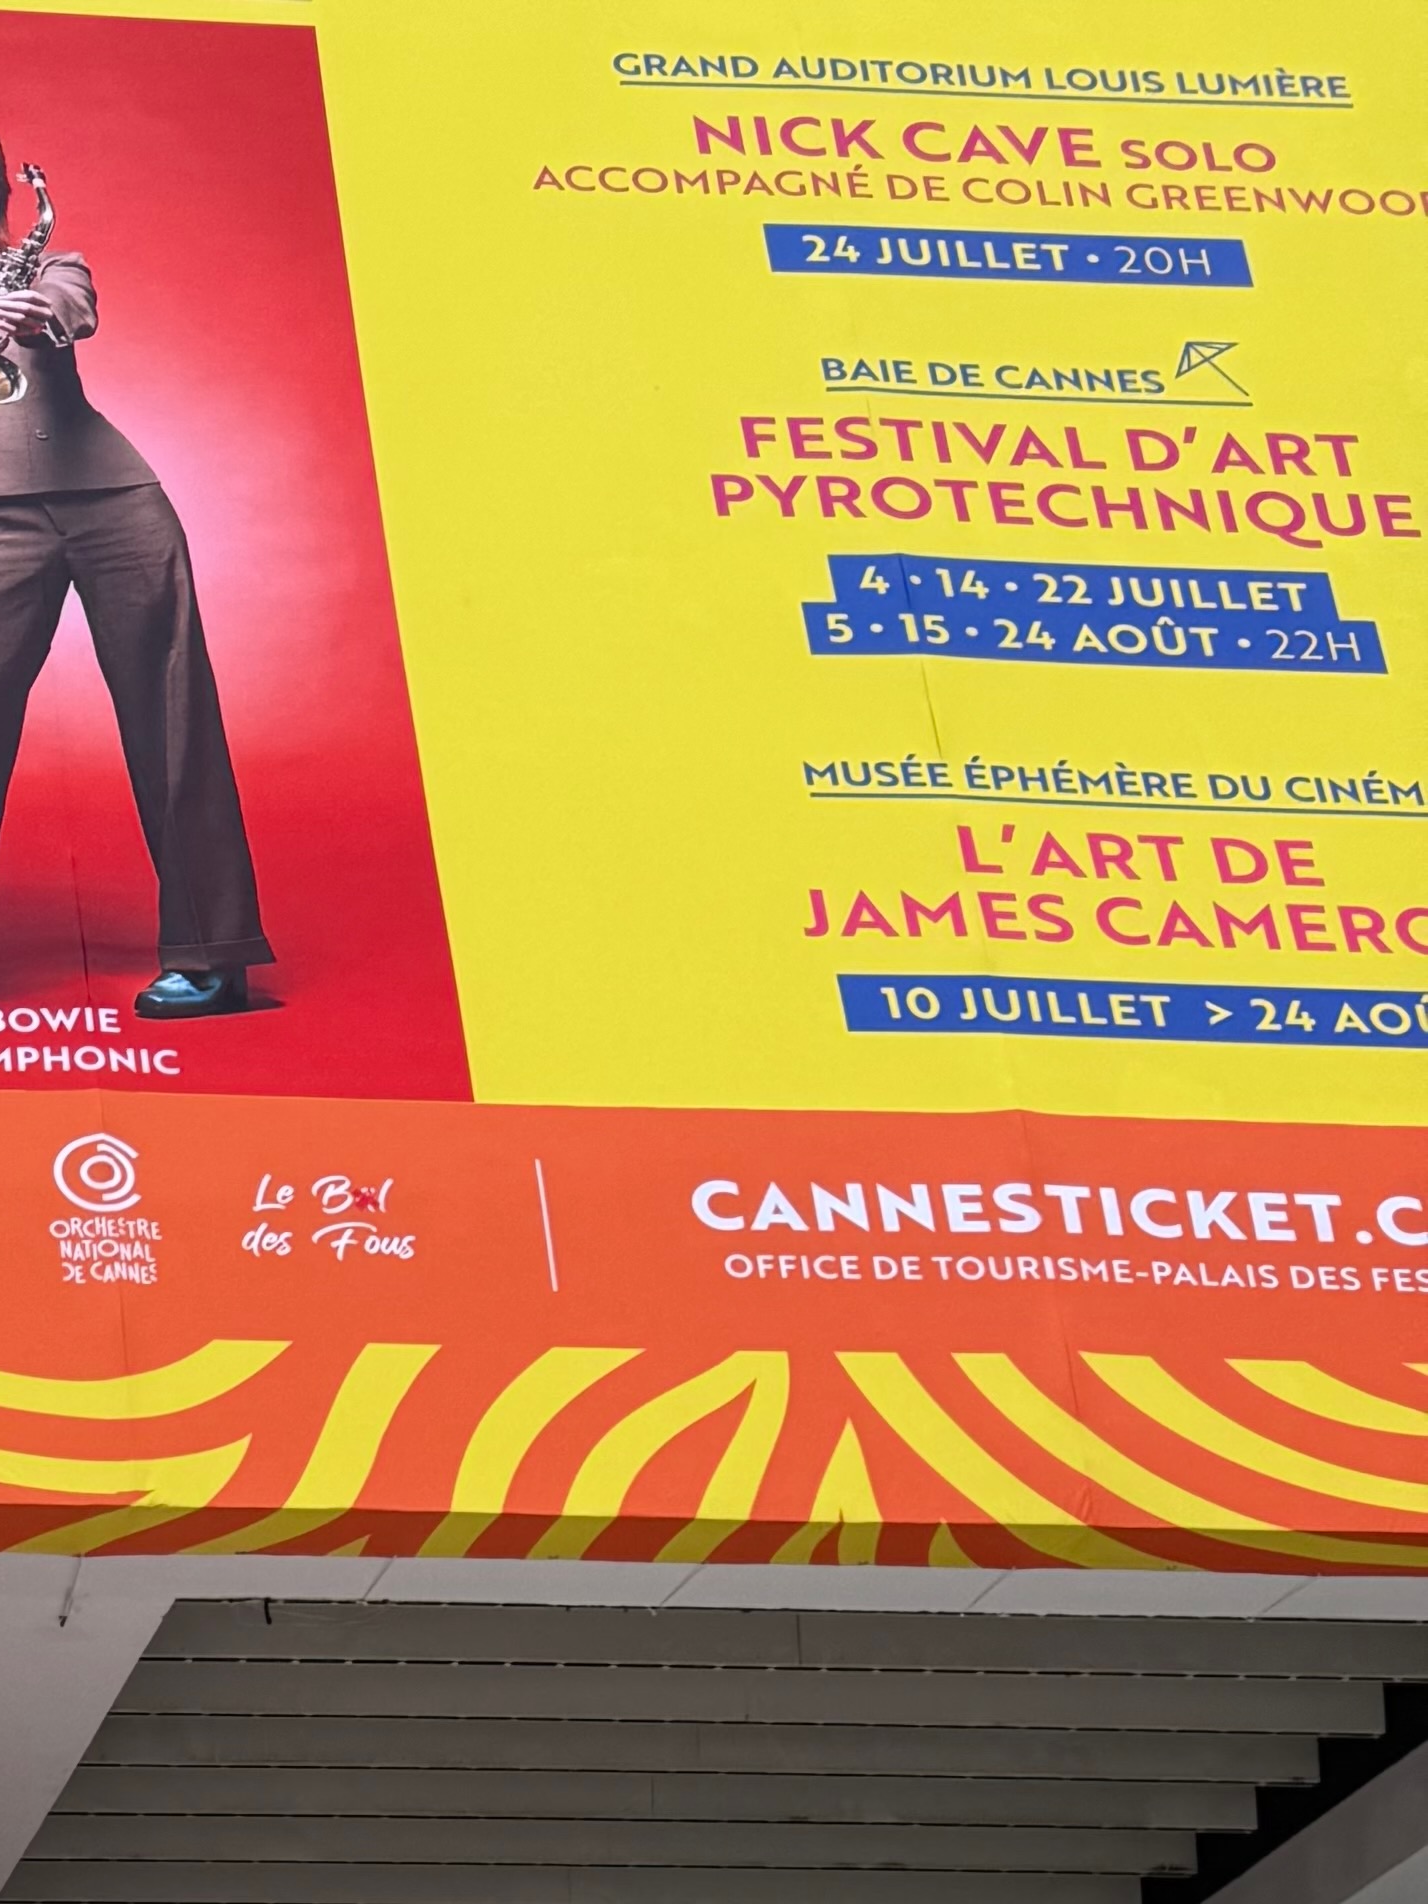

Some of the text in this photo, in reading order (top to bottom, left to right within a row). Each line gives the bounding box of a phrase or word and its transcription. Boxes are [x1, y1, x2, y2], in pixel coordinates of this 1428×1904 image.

[612, 52, 1350, 100] GRAND AUDITORIUM LOUIS LUMIÈRE
[693, 113, 1277, 173] NICK CAVE SOLO
[533, 163, 874, 201] ACCOMPAGNÉ
[887, 174, 948, 202] DE
[963, 177, 1110, 210] COLIN
[802, 233, 1212, 277] 24 JUILLET 20H
[820, 356, 1166, 395] BAIE DE CANNES
[739, 415, 1359, 477] FESTIVAL D'ART
[710, 473, 1422, 549] PYROTECHNIQUE
[858, 566, 1307, 612] 4 14 22 JUILLET
[827, 612, 1361, 661] 5 15 24 AOÛT 22H
[803, 754, 1428, 806] MUSÉE ÉPHÉMÈRE DU CINÉM
[956, 824, 1325, 887] L'ART DE
[803, 888, 1075, 943] JAMES
[880, 985, 940, 1021] 10
[959, 988, 1171, 1028] JUILLET
[1250, 998, 1316, 1032] 24
[252, 1173, 295, 1212] Le
[690, 1180, 1428, 1246] CANNESTICKET.C
[49, 1216, 162, 1240] ORCHESTRE
[59, 1238, 156, 1262] NATIONAL
[241, 1221, 416, 1262] des Fous
[61, 1260, 158, 1285] DE CANNES
[723, 1254, 862, 1281] OFFICE
[872, 1255, 921, 1282] DE
[931, 1255, 1280, 1289] TOURISME-PALAIS
[1289, 1265, 1361, 1291] DES
